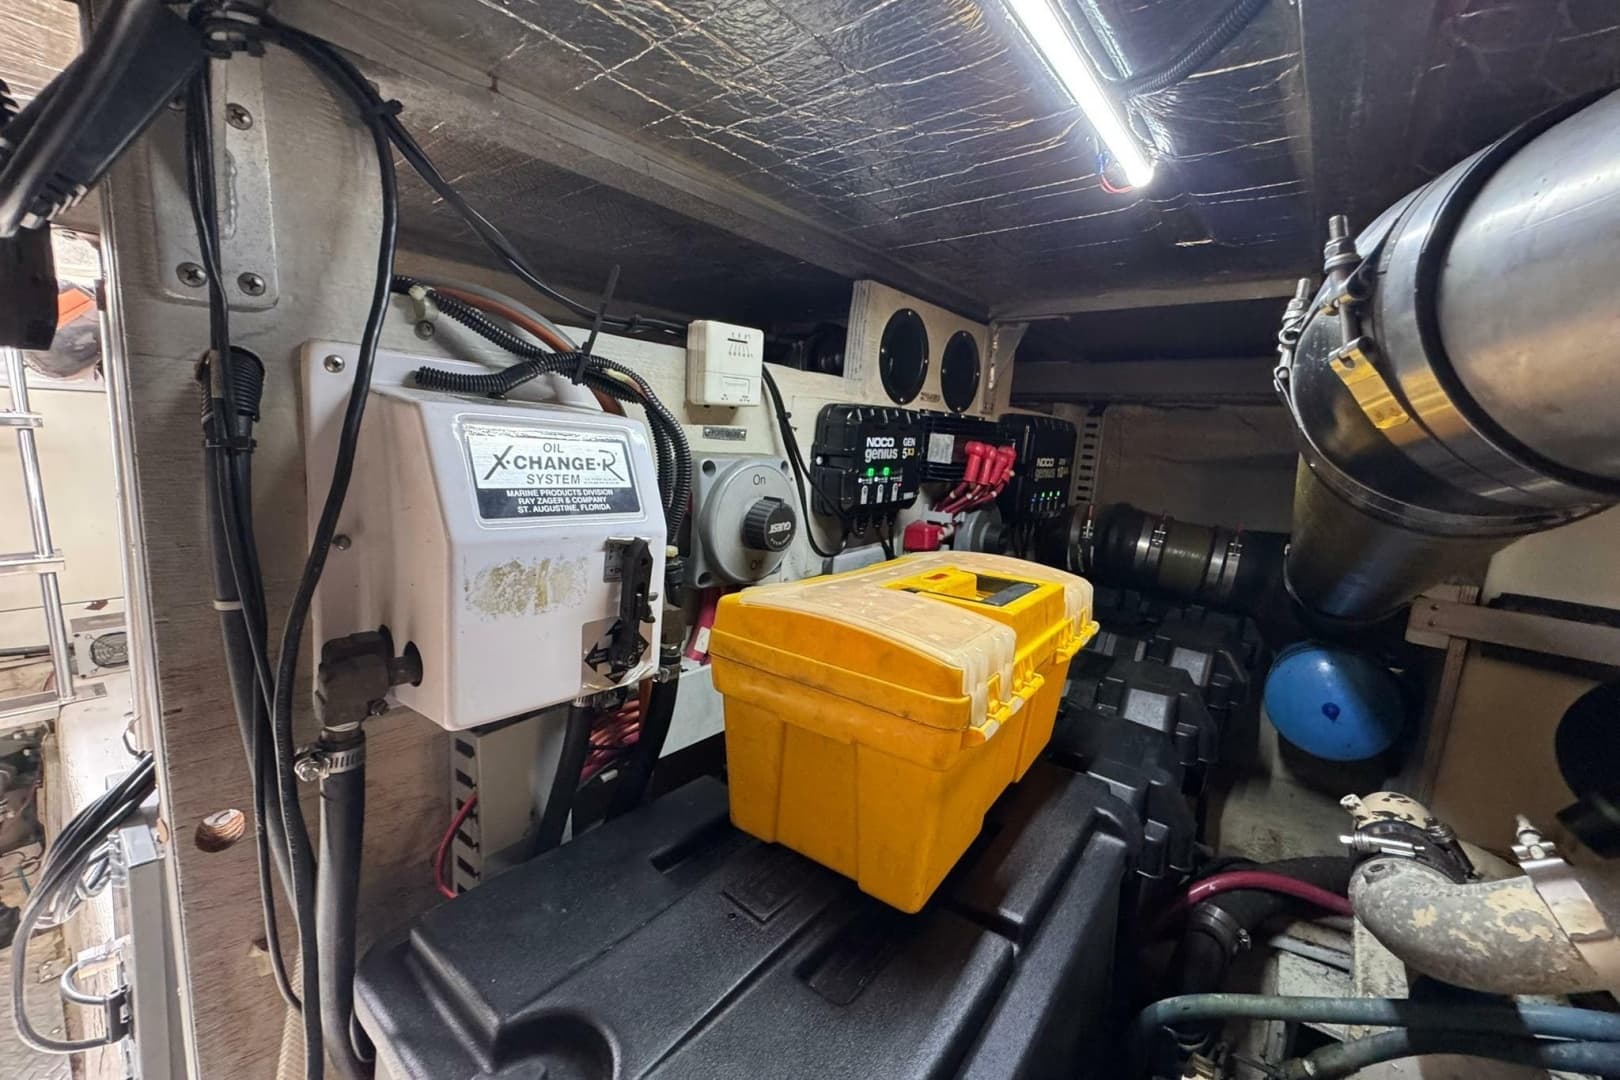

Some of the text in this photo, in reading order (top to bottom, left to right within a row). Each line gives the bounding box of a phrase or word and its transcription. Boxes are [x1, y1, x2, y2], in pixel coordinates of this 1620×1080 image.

[866, 437, 895, 447] NOCO
[543, 442, 564, 453] OIL
[864, 448, 898, 463] genius
[526, 473, 581, 485] SYSTEM
[752, 473, 766, 486] On
[506, 489, 539, 497] MARINE
[540, 489, 582, 497] PRODUCTS
[518, 497, 535, 505] RAY
[536, 497, 565, 505] ZAGER
[571, 496, 608, 504] COMPANY
[517, 505, 532, 513] ST.
[580, 503, 611, 511] FLORIDA
